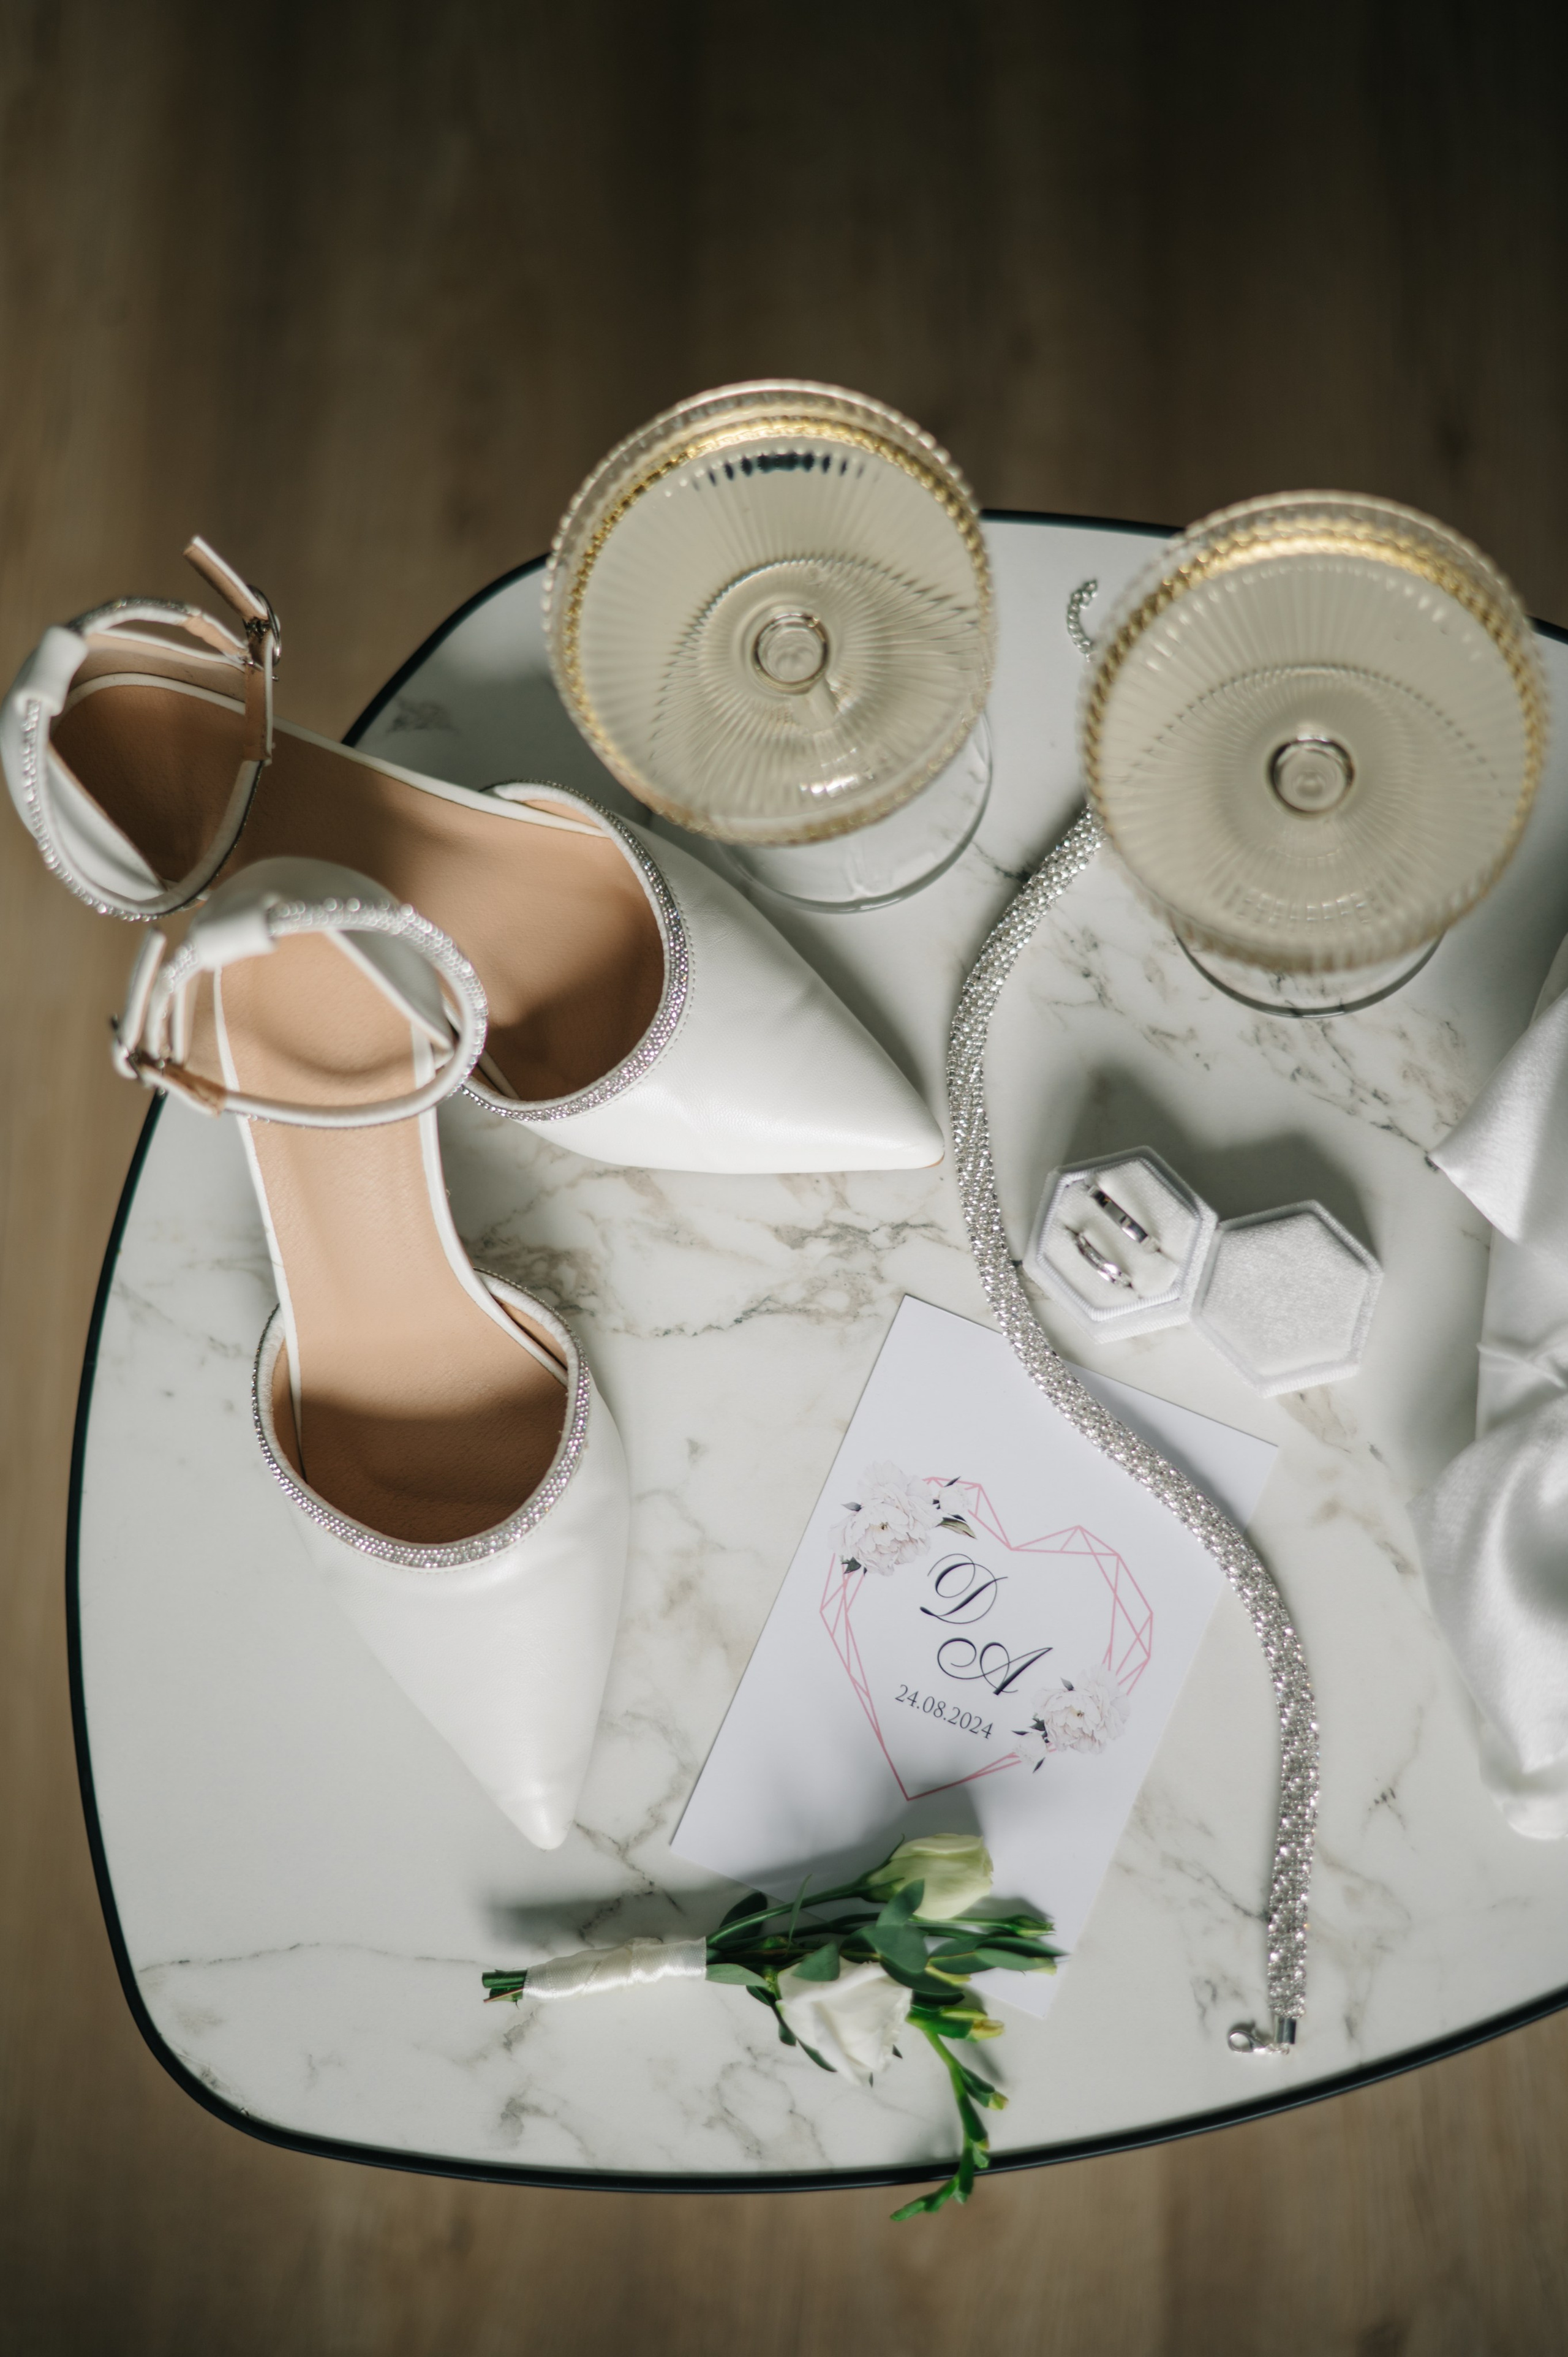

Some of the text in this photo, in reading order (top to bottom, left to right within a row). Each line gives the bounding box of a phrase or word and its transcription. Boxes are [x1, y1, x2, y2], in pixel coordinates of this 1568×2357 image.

[920, 1553, 1008, 1624] D
[937, 1637, 1054, 1695] A
[895, 1684, 993, 1739] 24.08.2024
